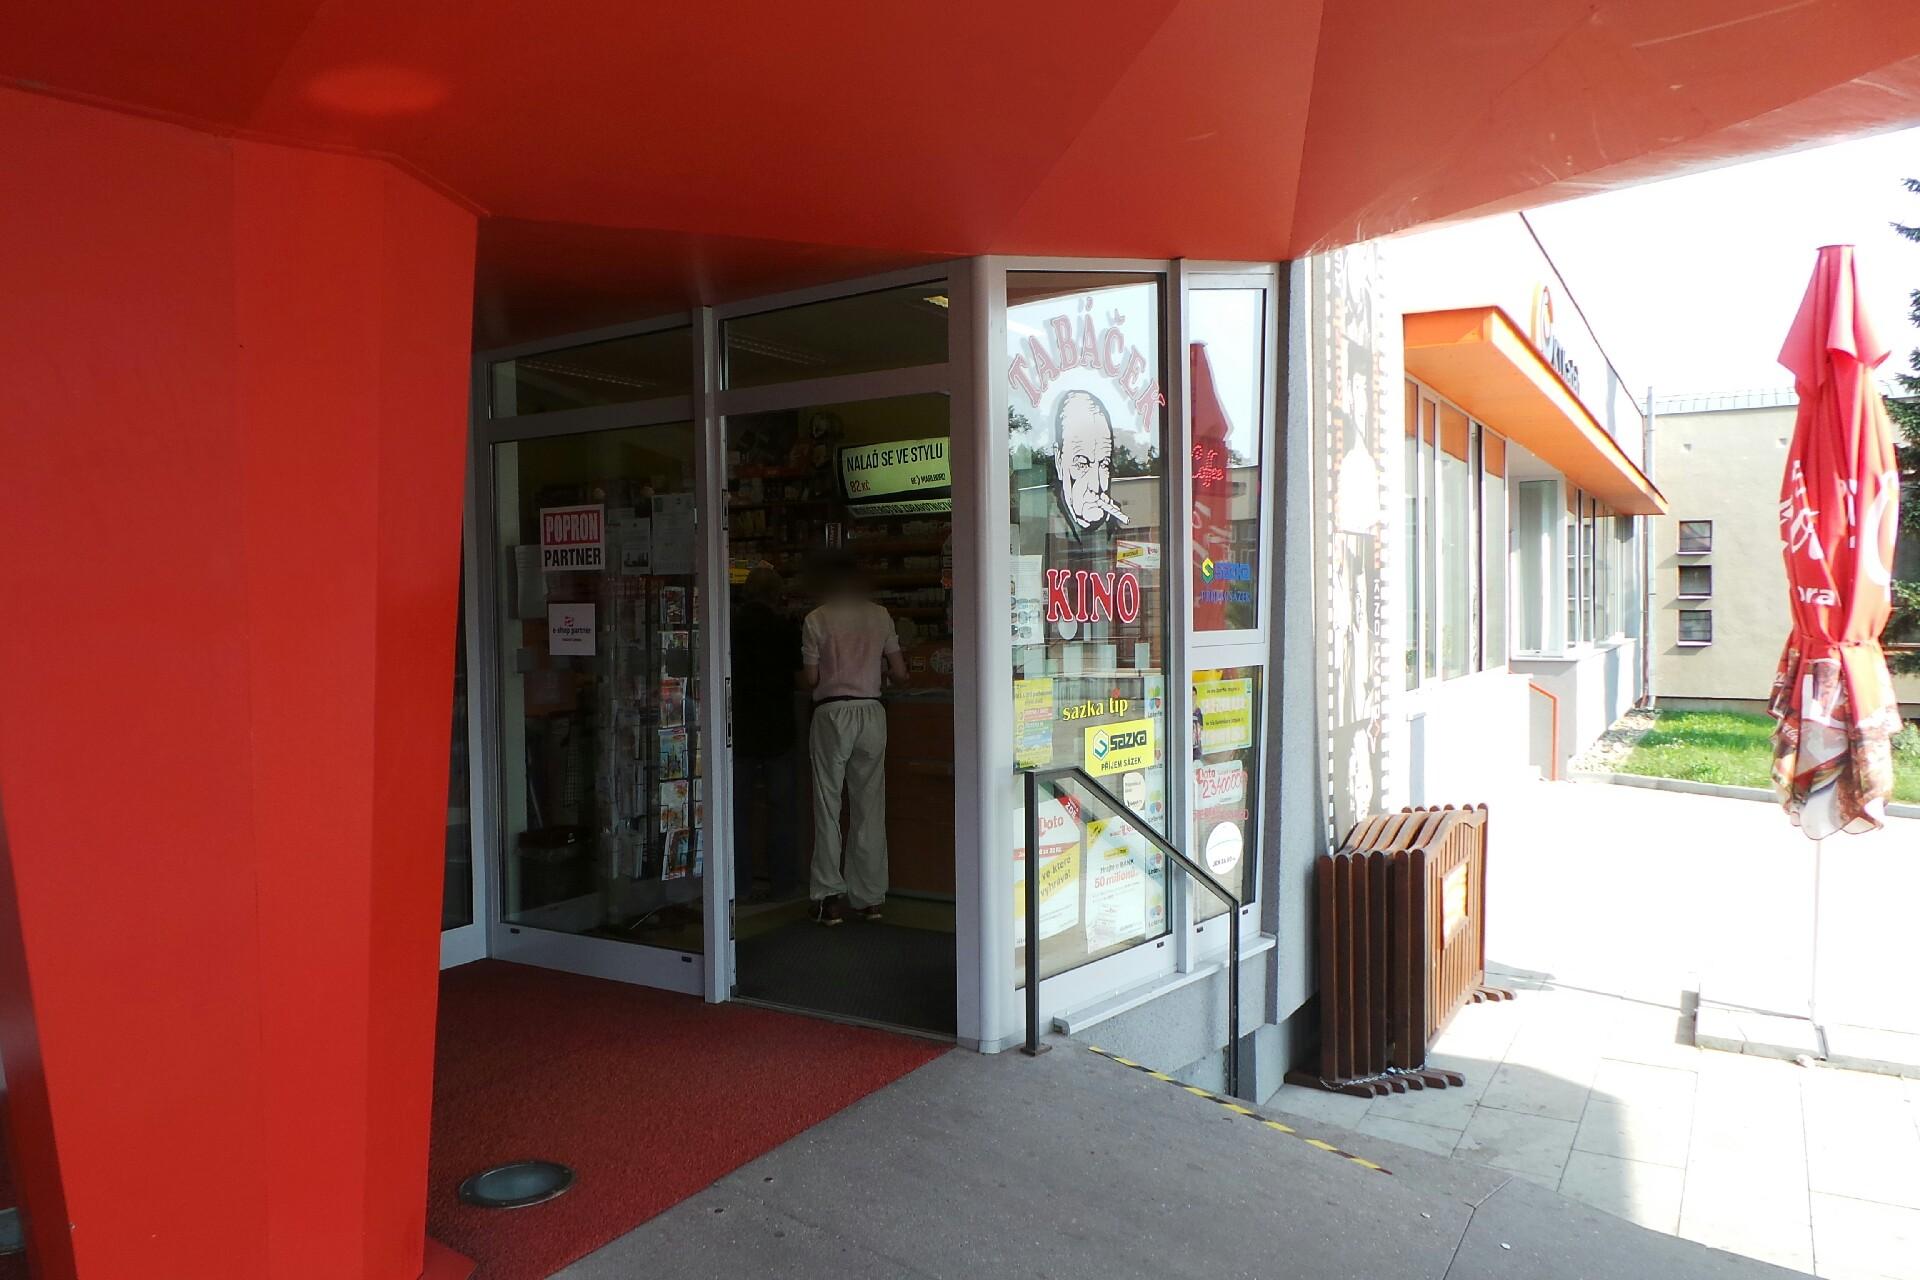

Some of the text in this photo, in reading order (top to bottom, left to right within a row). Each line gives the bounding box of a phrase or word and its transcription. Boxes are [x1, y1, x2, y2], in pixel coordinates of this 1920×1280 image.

[1009, 296, 1165, 432] TABÁČEK
[881, 450, 894, 467] SE
[896, 448, 909, 464] VE
[910, 443, 943, 463] STYLU
[850, 480, 861, 493] 82
[545, 513, 599, 543] POPRON
[544, 547, 601, 567] PARTNER
[1046, 568, 1140, 624] KINO
[1062, 700, 1104, 721] sazka
[1109, 694, 1128, 717] tip
